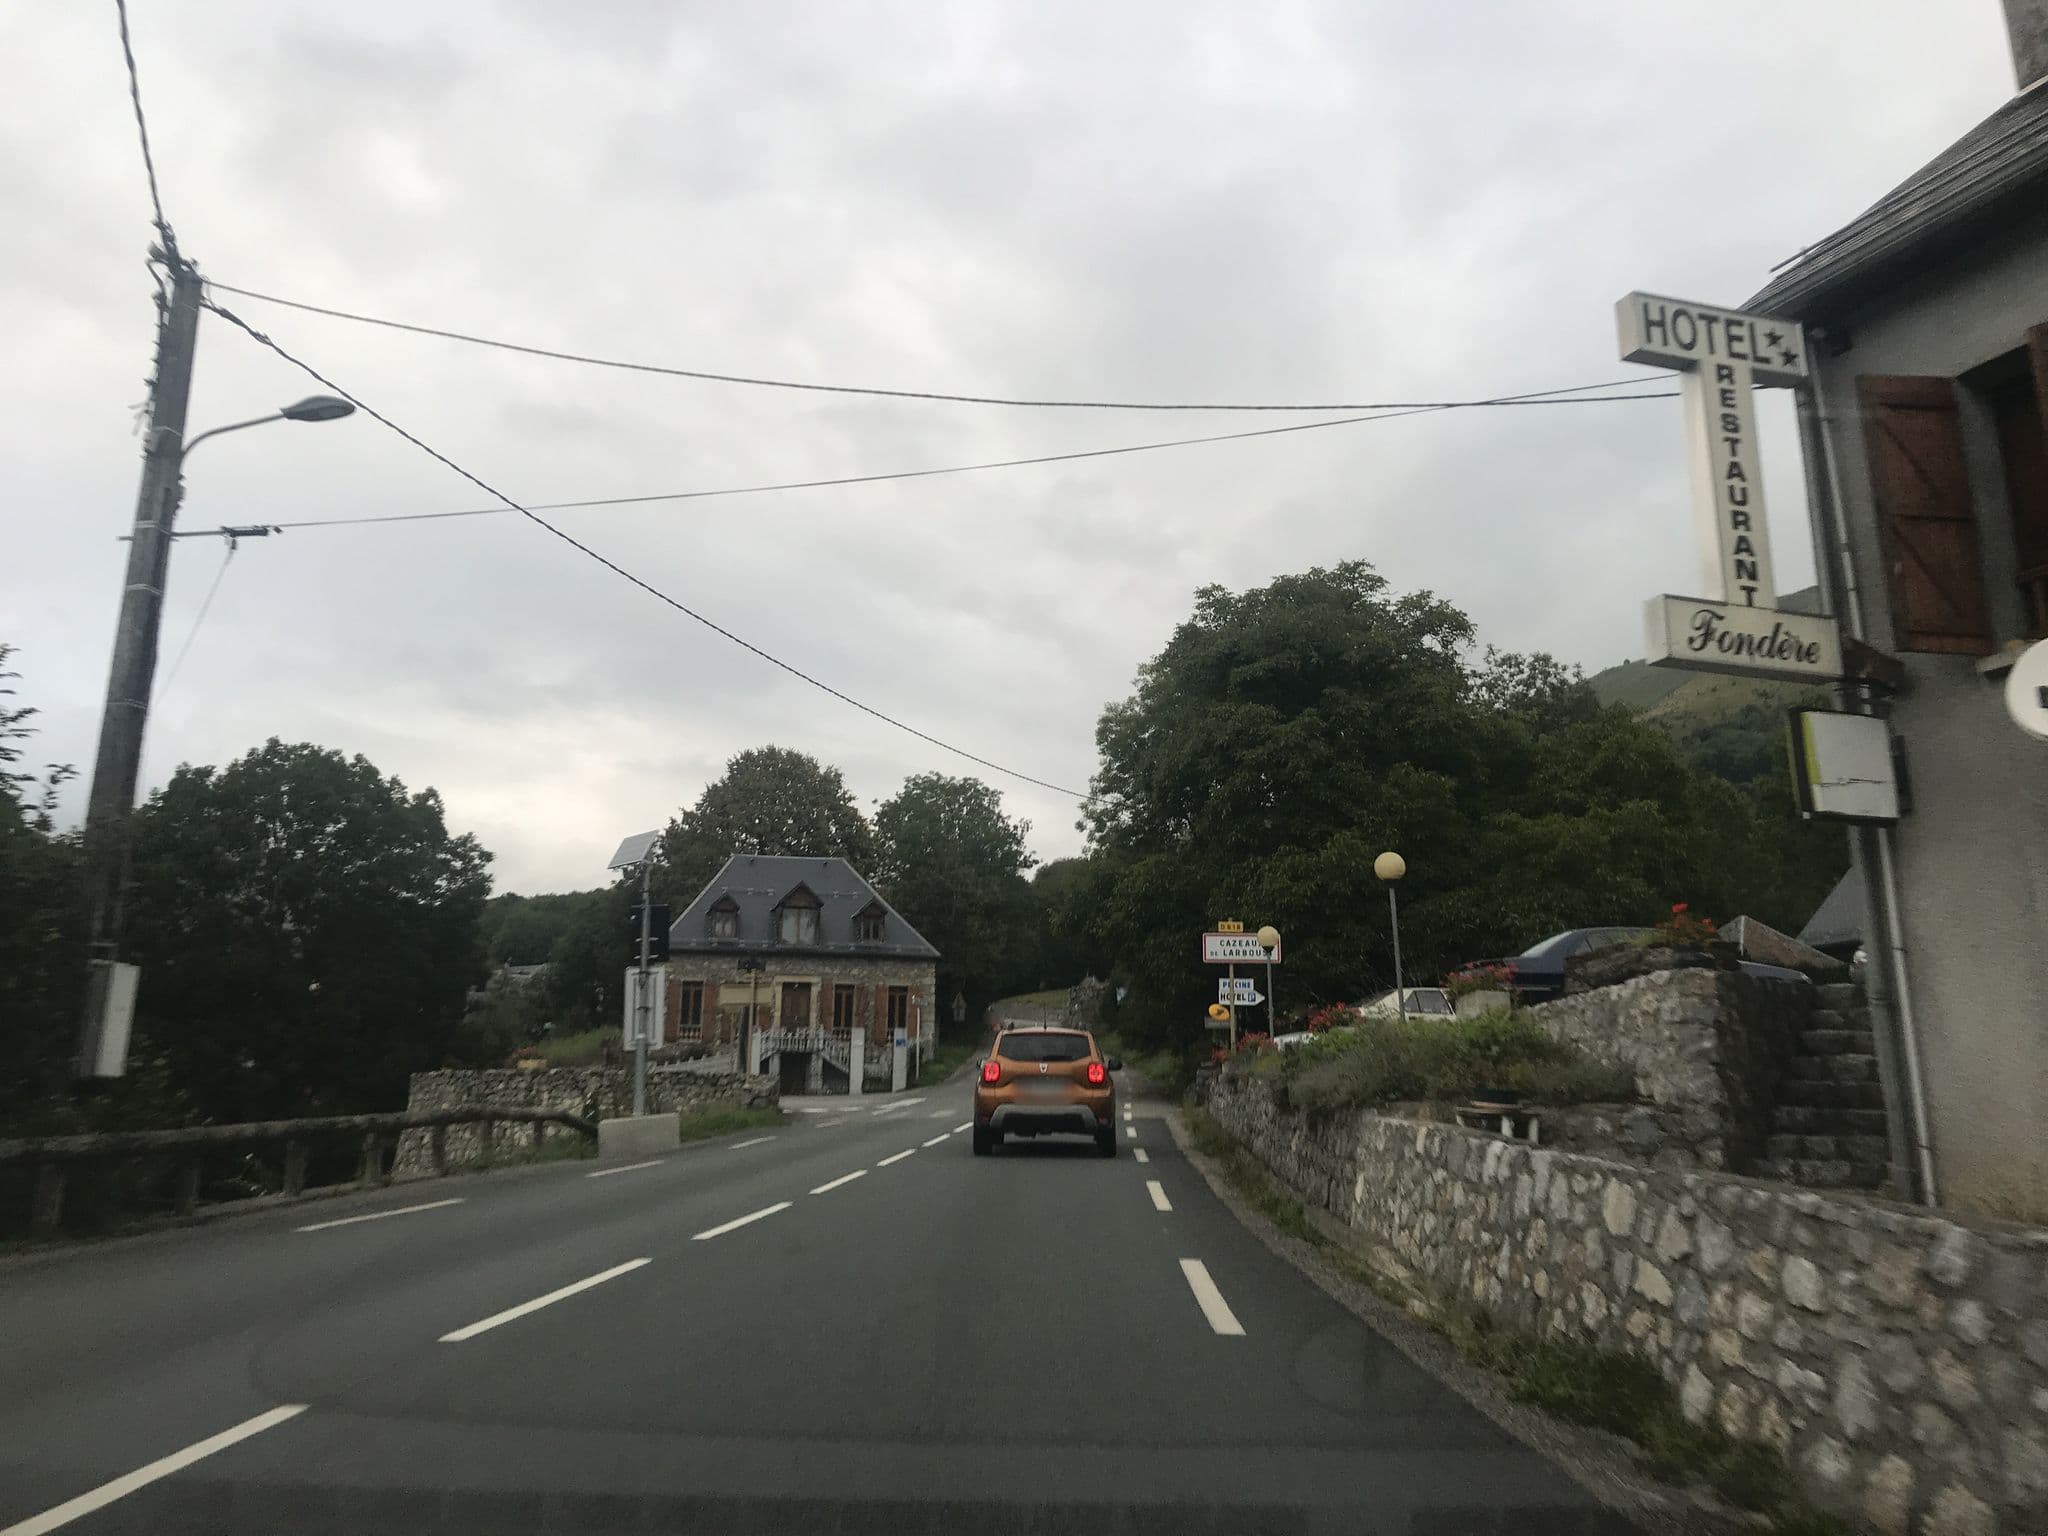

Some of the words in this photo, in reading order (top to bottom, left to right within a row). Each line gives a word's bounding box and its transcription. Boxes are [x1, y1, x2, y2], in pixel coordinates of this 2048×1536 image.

[1643, 302, 1773, 364] HOTEL
[1716, 364, 1757, 608] RESTAURANT
[1688, 608, 1820, 664] Fondère
[1219, 939, 1261, 947] CAZEAU
